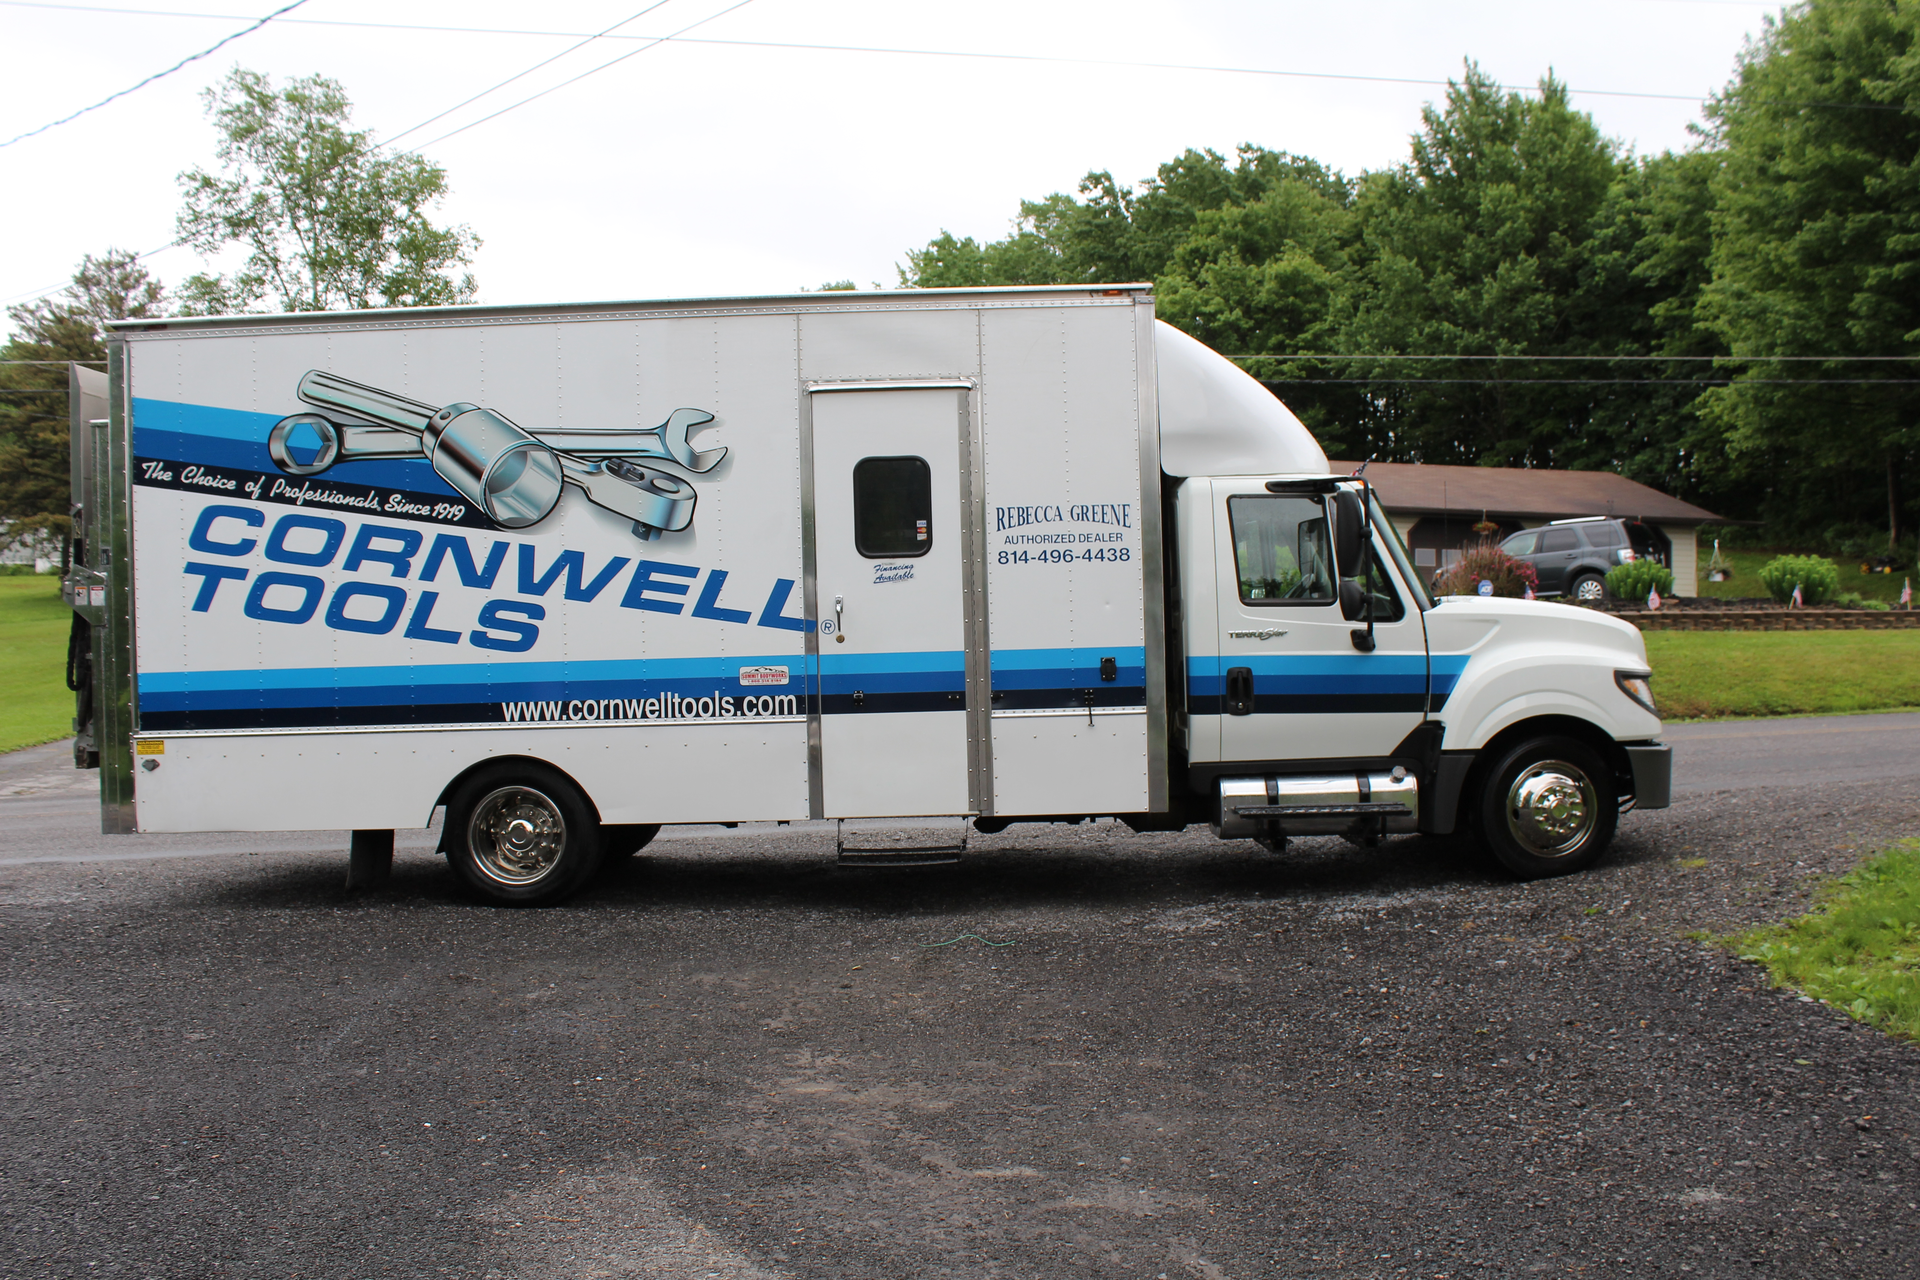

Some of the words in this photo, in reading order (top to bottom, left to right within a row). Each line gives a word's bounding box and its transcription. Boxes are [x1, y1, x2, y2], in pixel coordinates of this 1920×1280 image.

[141, 461, 173, 482] The
[180, 465, 237, 490] Choice
[244, 475, 266, 500] of
[384, 493, 431, 517] Since
[431, 502, 466, 522] 1919
[995, 505, 1064, 532] REBECCA
[1070, 503, 1132, 529] GREENE
[1004, 533, 1076, 545] AUTHORIZED
[1078, 532, 1124, 543] DEALER
[188, 504, 818, 634] CORNWELL
[873, 564, 914, 575] Financing
[997, 547, 1131, 565] 814-496-4438
[873, 571, 914, 584] Available
[183, 561, 547, 653] TOOLS
[501, 690, 797, 721] www.cornwelltools.com
